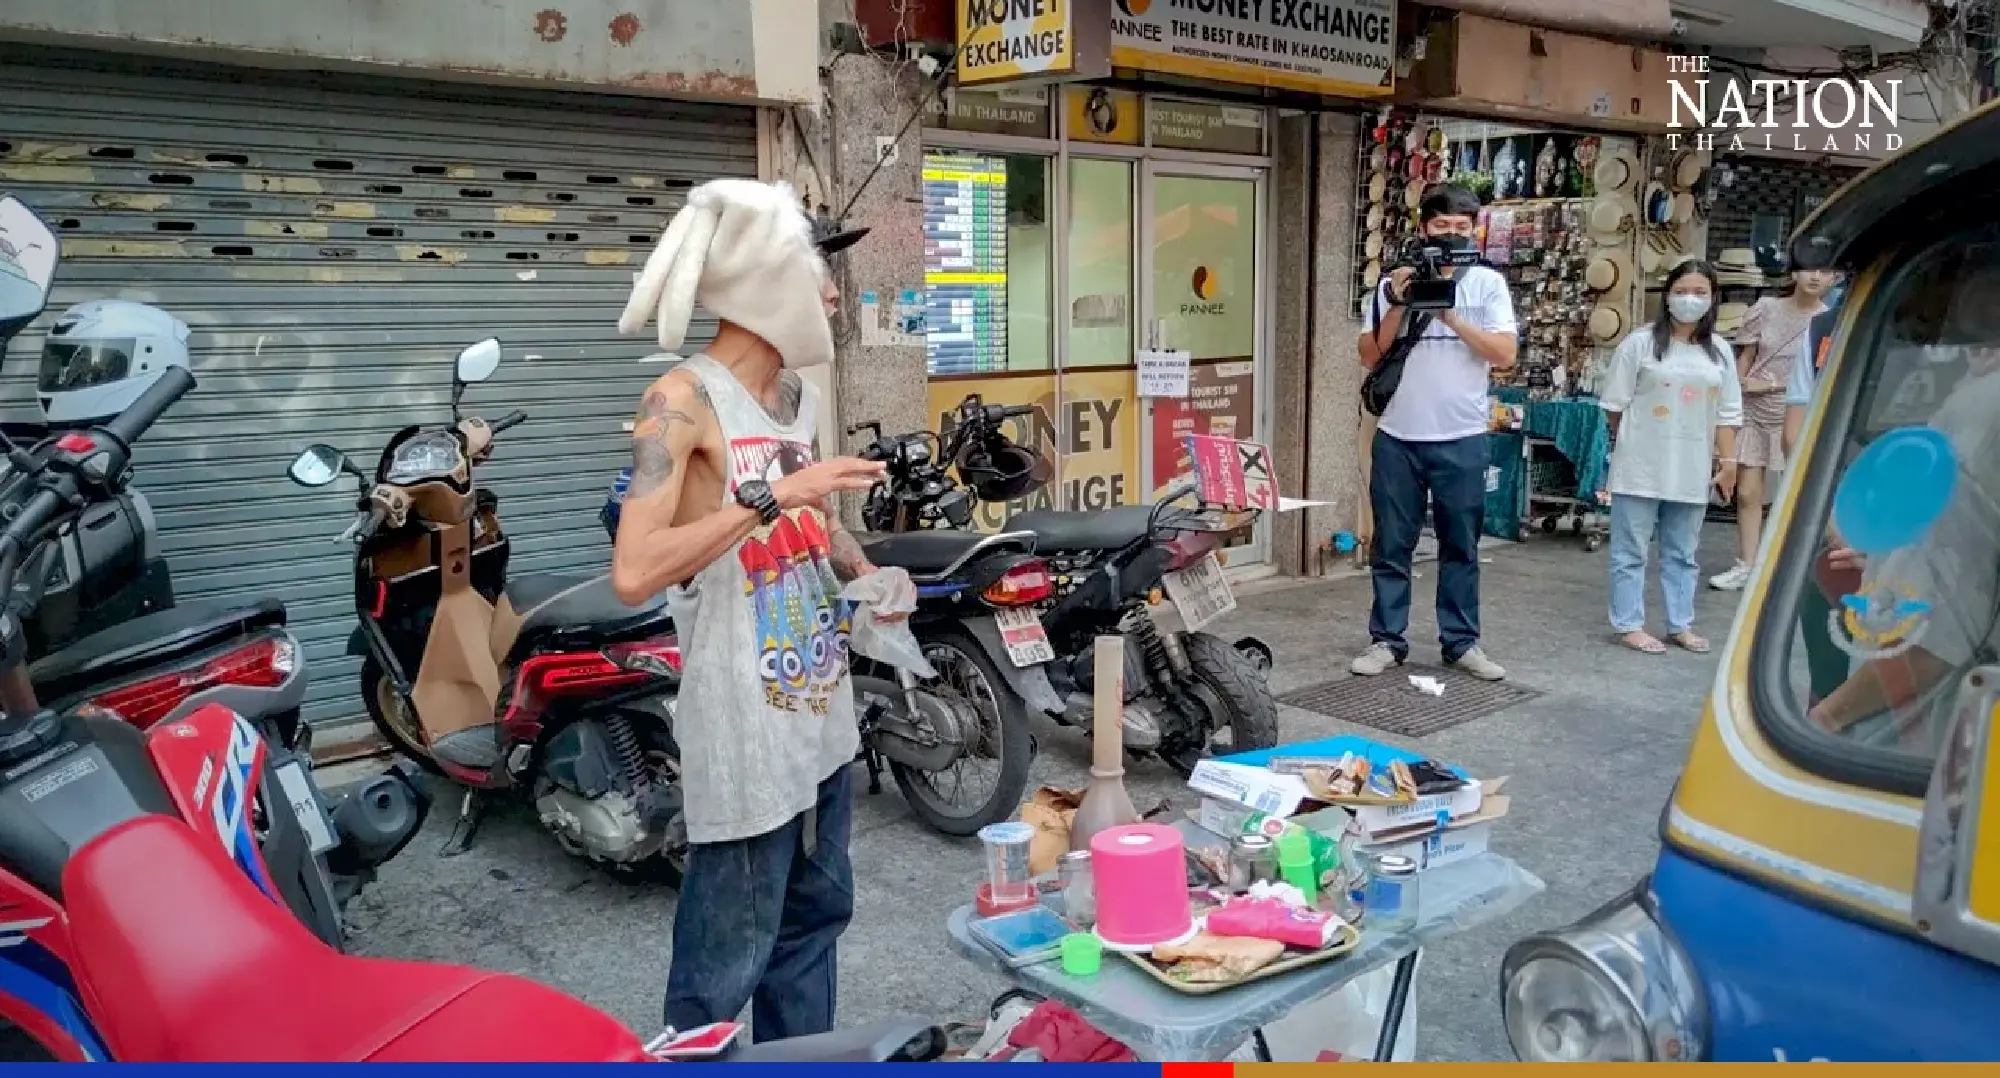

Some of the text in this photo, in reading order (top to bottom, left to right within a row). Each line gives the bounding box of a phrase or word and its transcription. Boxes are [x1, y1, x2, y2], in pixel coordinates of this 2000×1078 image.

[1110, 18, 1162, 42] ANNEE
[1169, 0, 1390, 45] NEY EXCHANGE
[966, 29, 1065, 67] EXCHANGE
[1171, 19, 1197, 39] THE
[1202, 25, 1233, 45] BEST
[1236, 31, 1269, 52] RATE
[1272, 37, 1287, 54] IN
[1291, 41, 1390, 70] KHAOSANROAD
[958, 104, 972, 118] IN
[974, 104, 1037, 124] THAILAND
[1161, 125, 1204, 139] THAILAND
[1180, 302, 1225, 317] PANNEE
[941, 397, 1123, 460] ONEY
